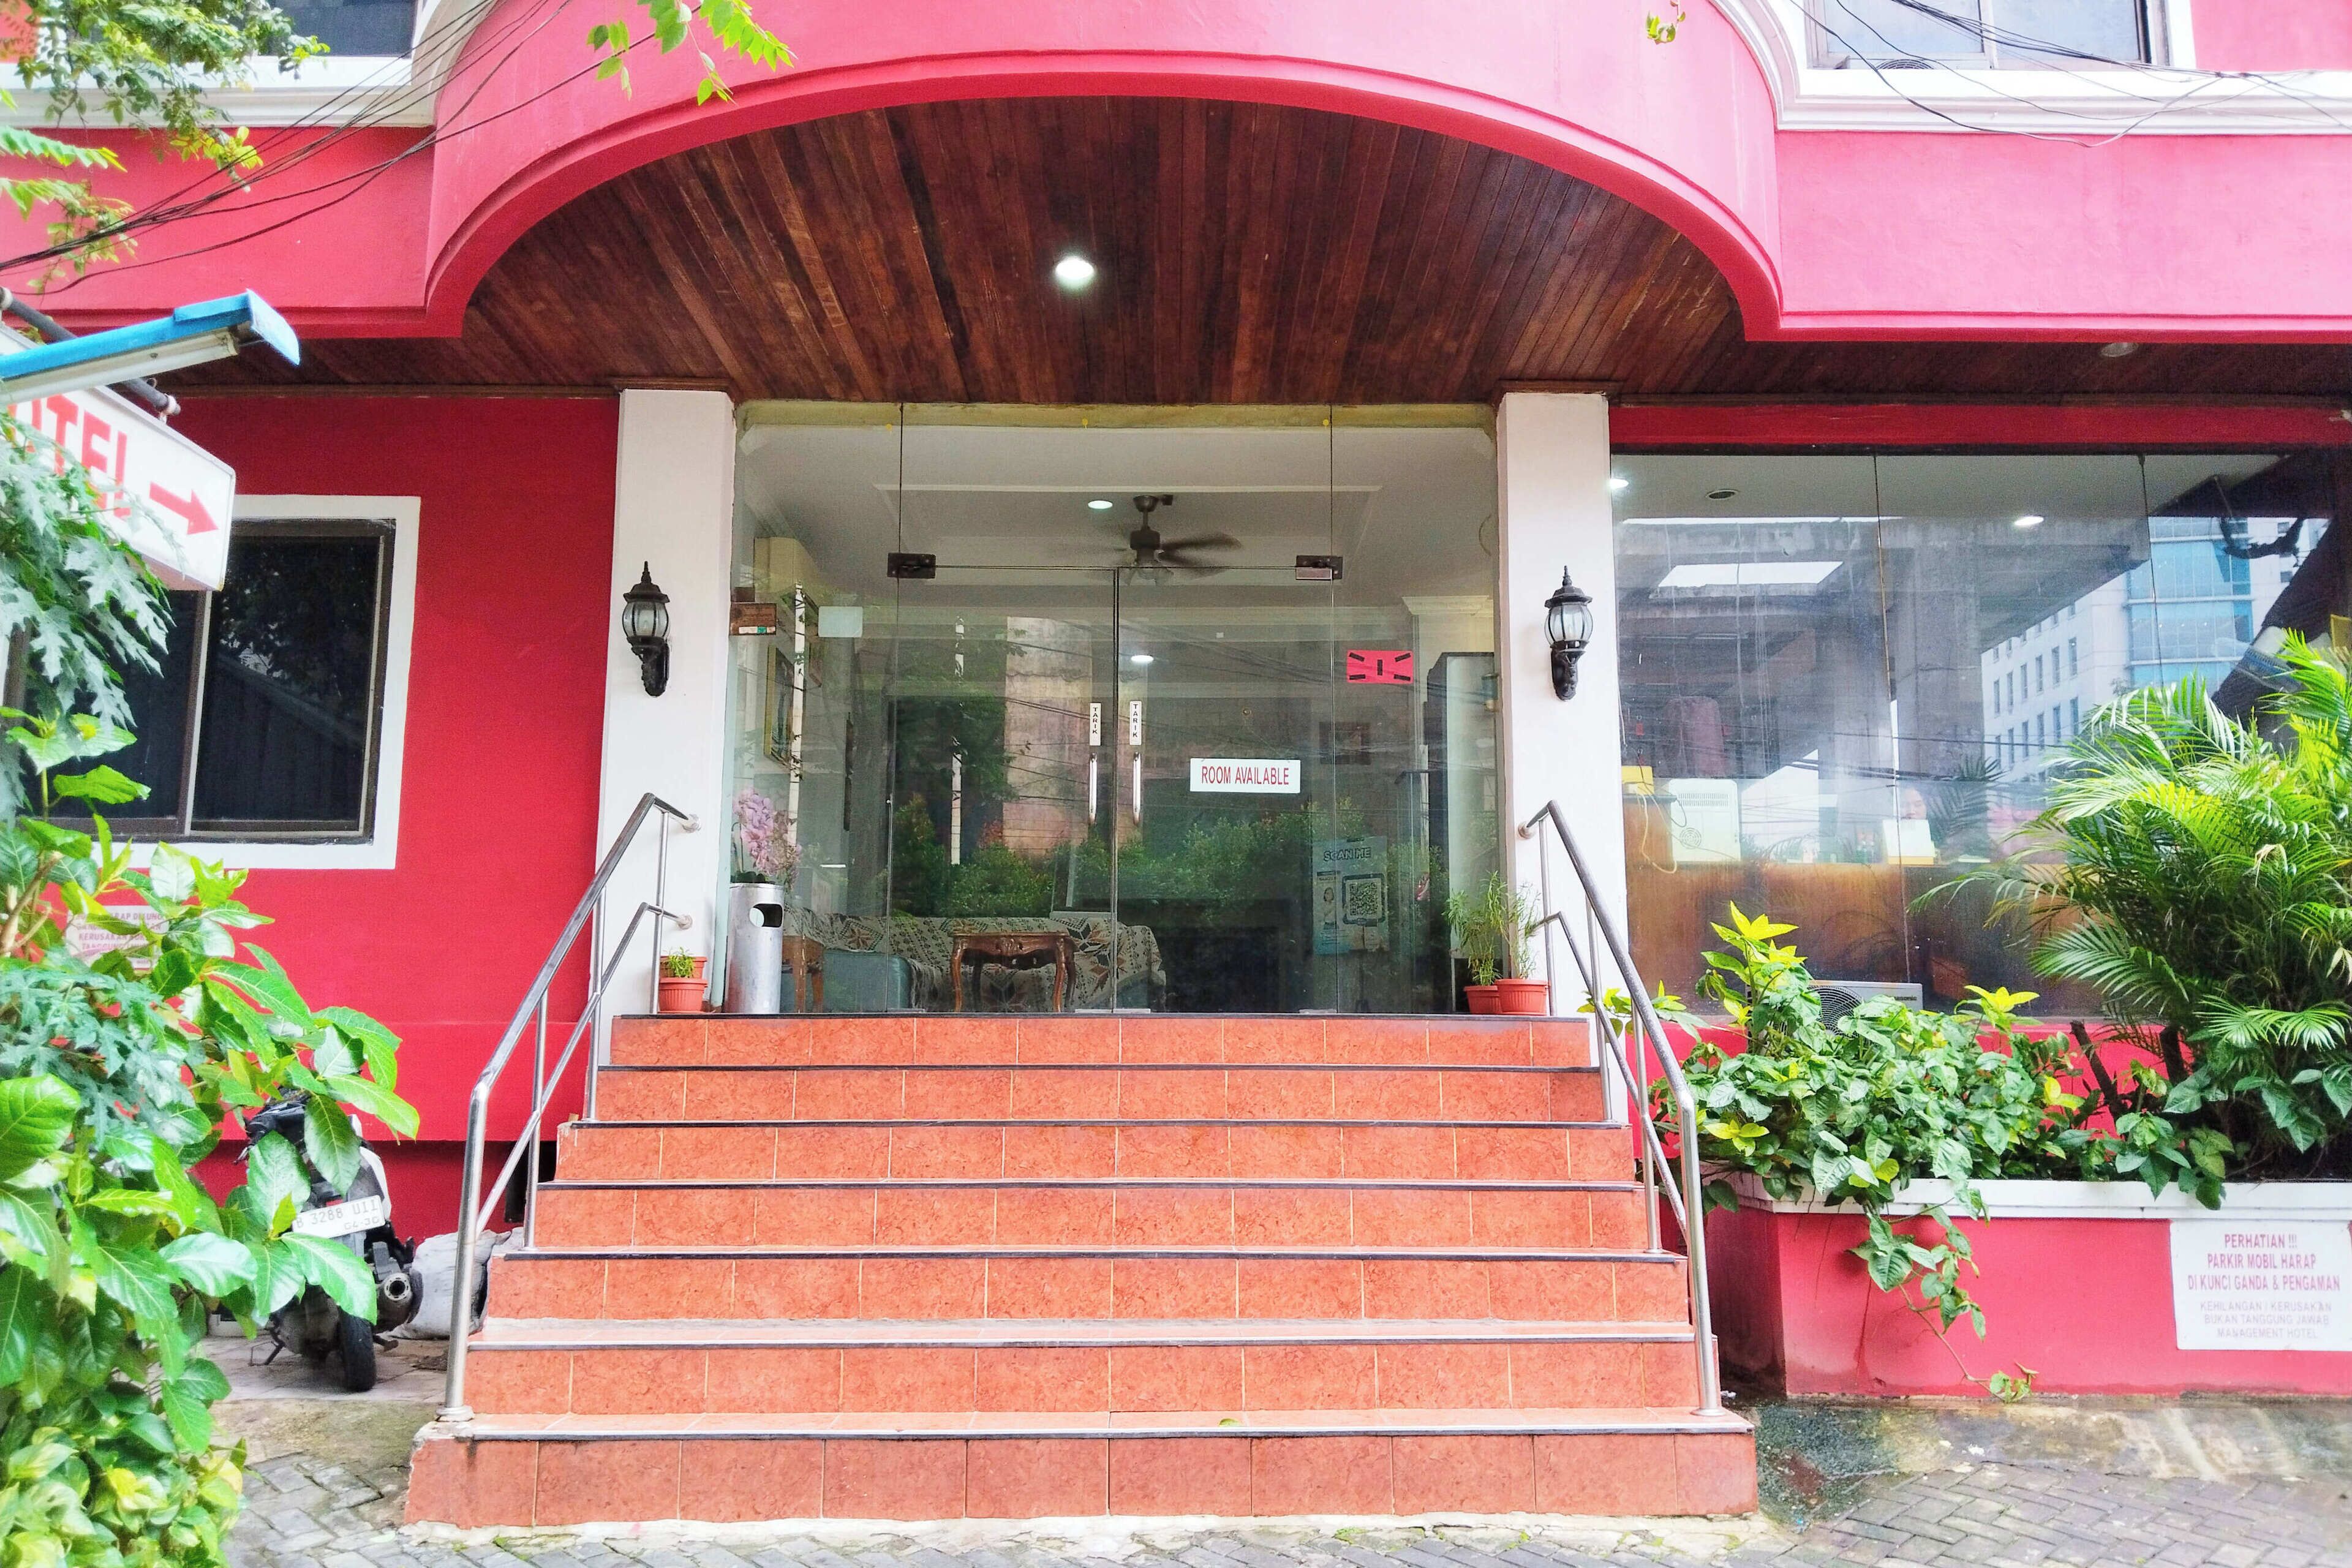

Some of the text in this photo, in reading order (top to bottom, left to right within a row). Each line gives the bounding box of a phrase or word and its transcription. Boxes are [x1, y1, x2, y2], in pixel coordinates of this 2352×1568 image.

[1202, 766, 1289, 785] ROOM AVAILABLE
[1323, 846, 1371, 862] SCAN ME
[296, 1216, 304, 1229] B
[310, 1207, 344, 1224] 3288
[2224, 1234, 2297, 1248] PERHATIAN !!!
[2207, 1253, 2316, 1270] PARKIR MOBIL HARAP
[2188, 1275, 2340, 1291] DI KUNCI GANDA & PENGAMAN
[2200, 1301, 2262, 1311] KEHILANGAN
[2271, 1301, 2332, 1312] KERUSAKAN
[2204, 1314, 2329, 1325] BUKAN TANGGUNG JAWAB
[2217, 1328, 2318, 1338] MANAGEMENT HOTEL
